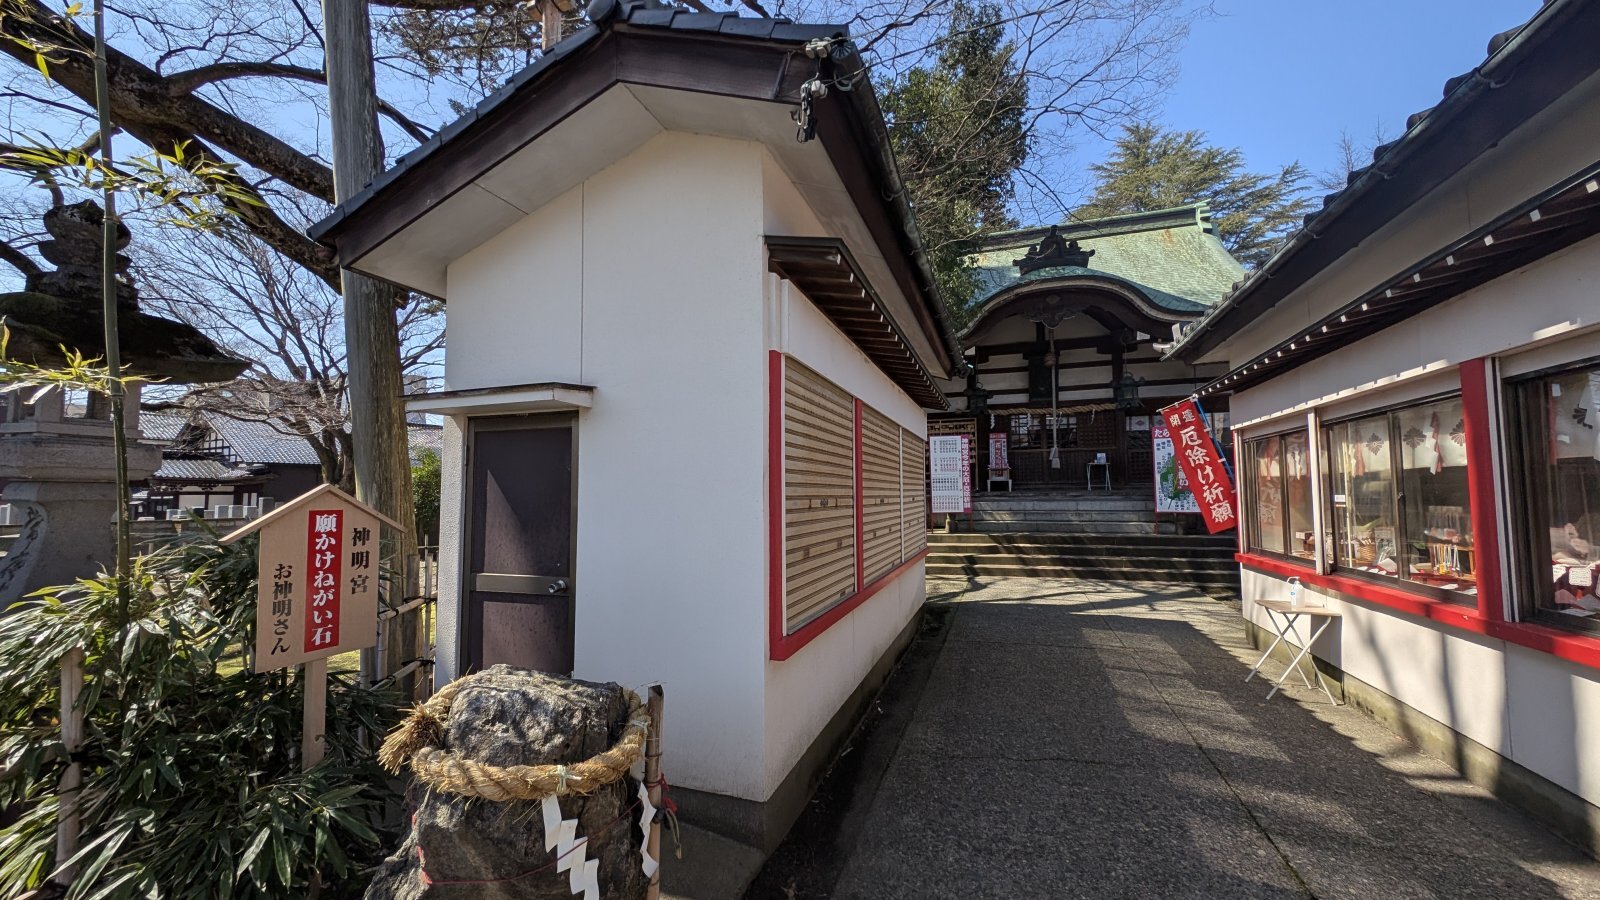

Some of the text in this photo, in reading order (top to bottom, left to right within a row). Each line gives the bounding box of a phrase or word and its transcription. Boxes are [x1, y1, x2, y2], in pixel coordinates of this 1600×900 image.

[1169, 409, 1195, 427] 開運
[1180, 425, 1234, 523] 厄除け祈願
[311, 514, 337, 646] 願かけねがい石
[350, 527, 371, 595] 神明宮
[271, 563, 293, 655] お神明さん
